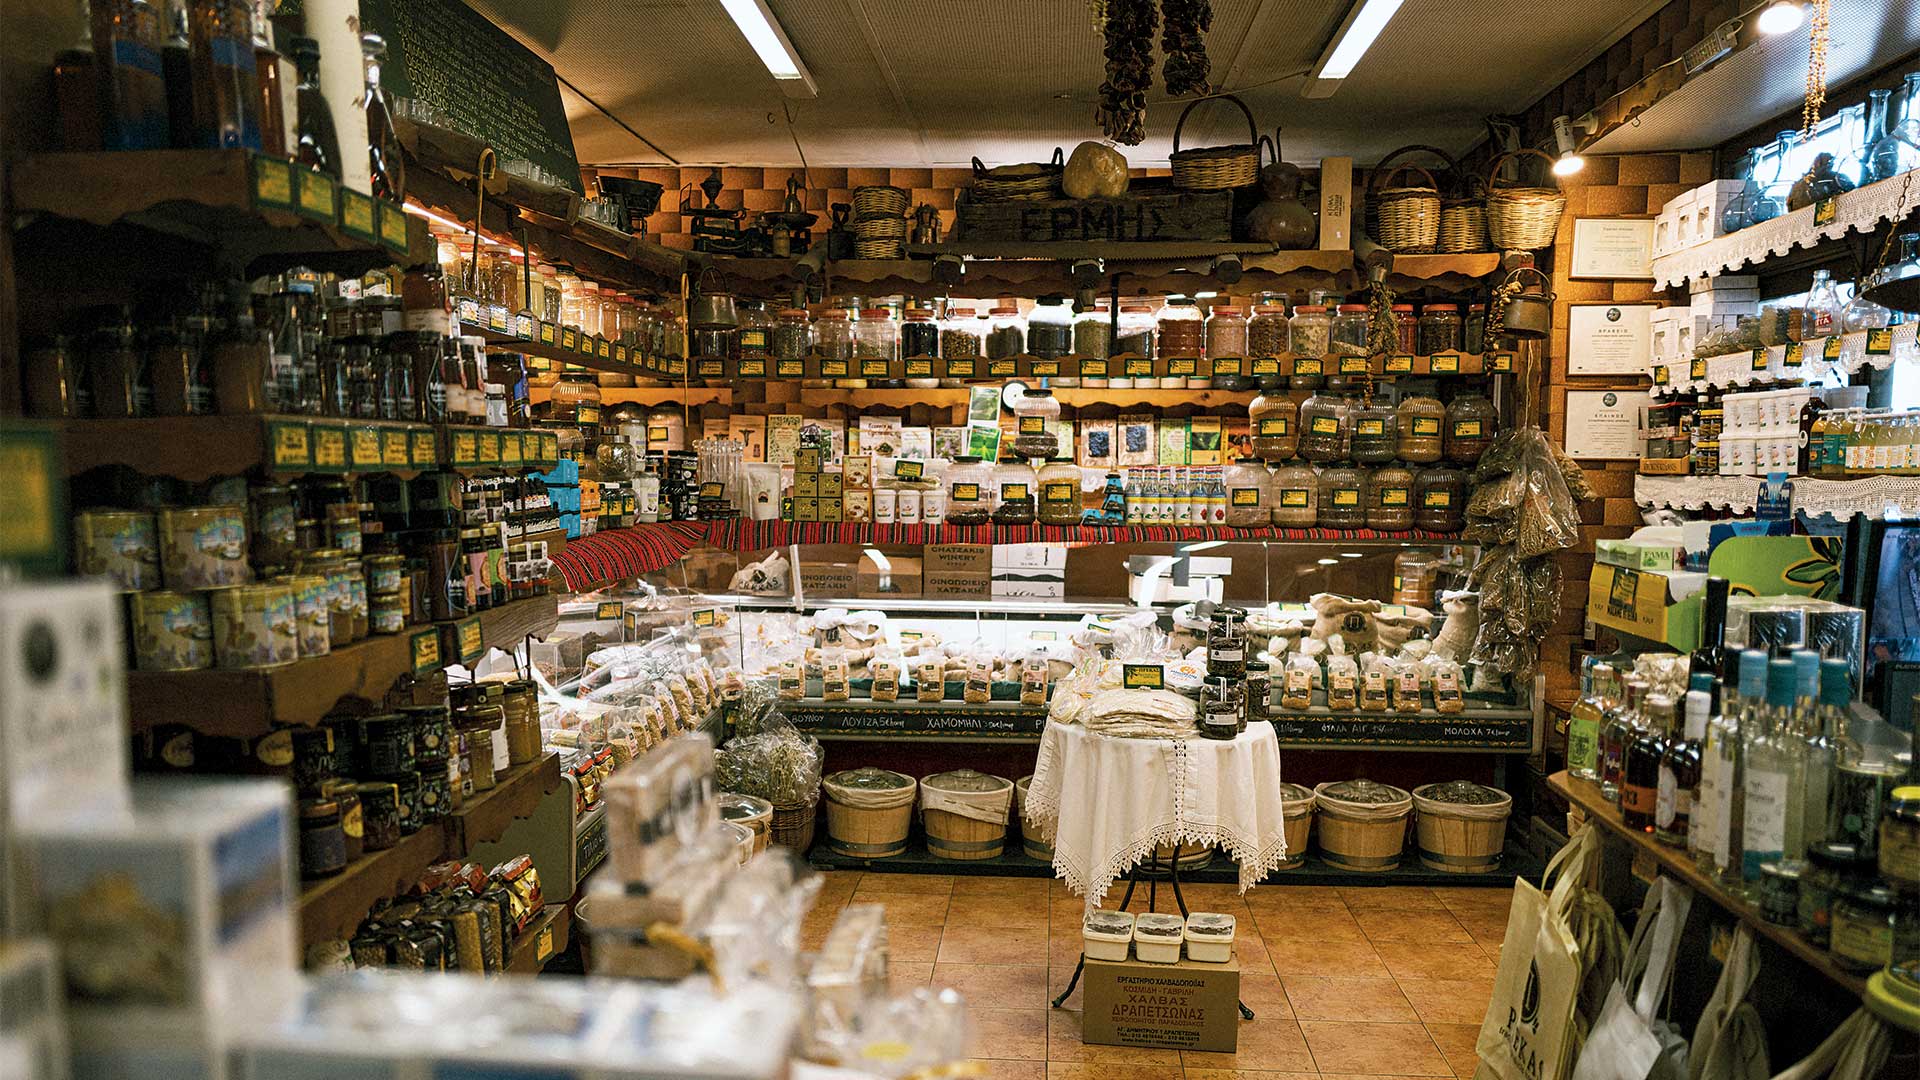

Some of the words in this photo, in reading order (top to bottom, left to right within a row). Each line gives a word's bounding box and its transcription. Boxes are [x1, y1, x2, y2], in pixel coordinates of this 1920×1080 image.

[1021, 203, 1169, 241] ΕΡΜΗΣ
[1644, 551, 1670, 559] FAMA
[926, 718, 982, 728] ΧΑΜΟΜΗΛΙ
[1444, 727, 1484, 736] ΜΟΛΟΧΑ
[1117, 976, 1155, 985] ΕΡΓΑΣΤΗΡΙΟ
[1128, 995, 1188, 1006] ΧΑΛΒΑΣ
[1112, 1004, 1205, 1020] ΔΡΑΠΕΤΣΩΝΑΣ
